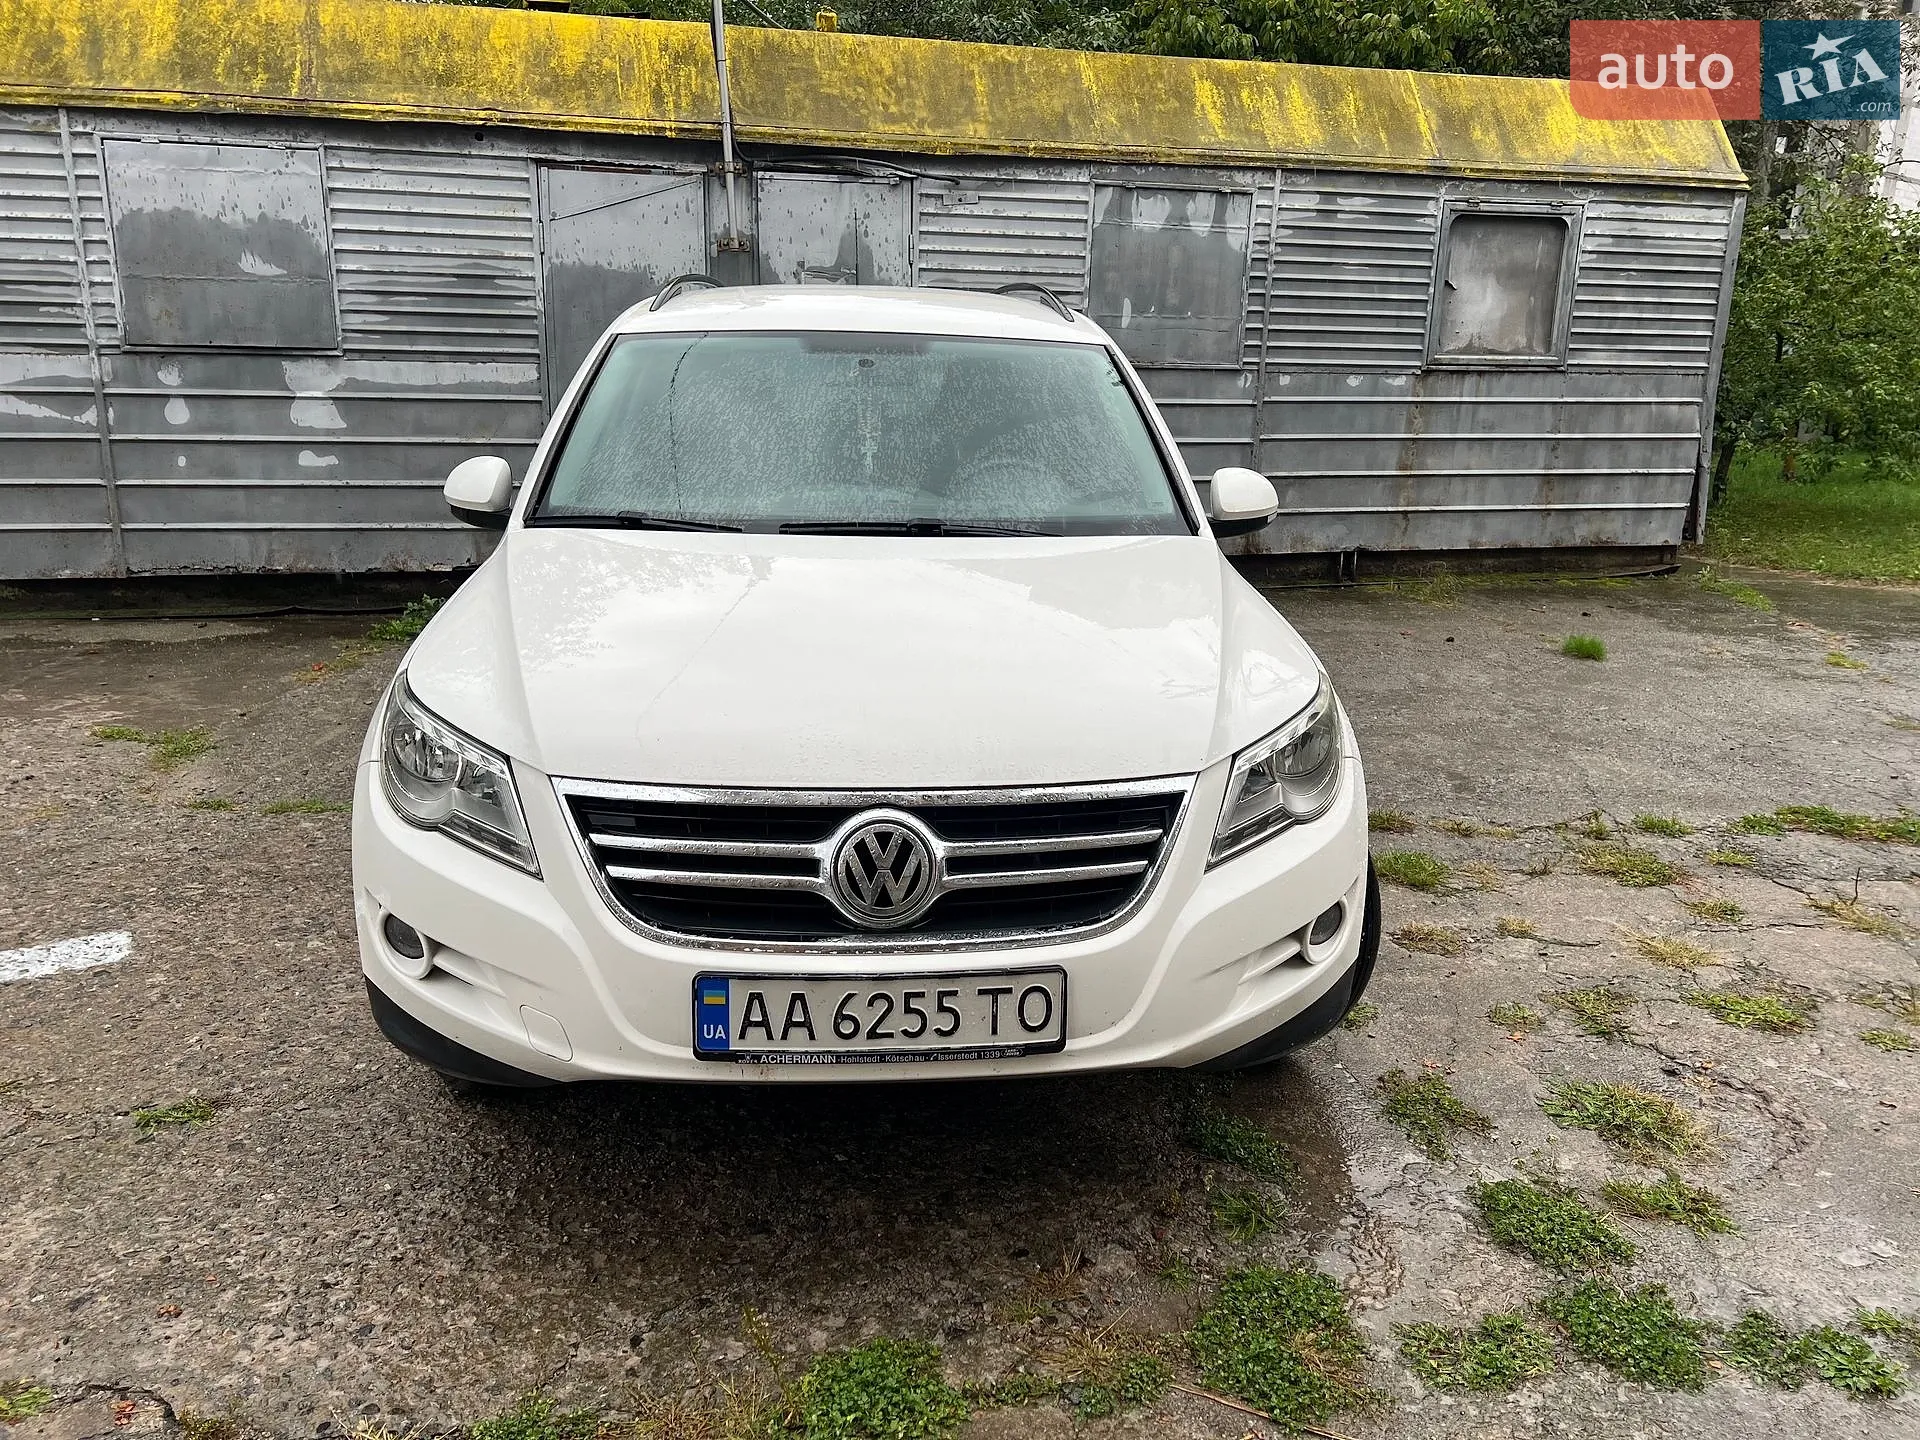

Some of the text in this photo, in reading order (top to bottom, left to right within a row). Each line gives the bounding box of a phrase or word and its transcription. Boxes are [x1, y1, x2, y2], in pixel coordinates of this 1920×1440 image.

[738, 984, 1053, 1041] AA 6255 TO
[703, 1024, 727, 1041] UA
[760, 1054, 836, 1064] ACHERMANN
[980, 1050, 1000, 1059] 1339
